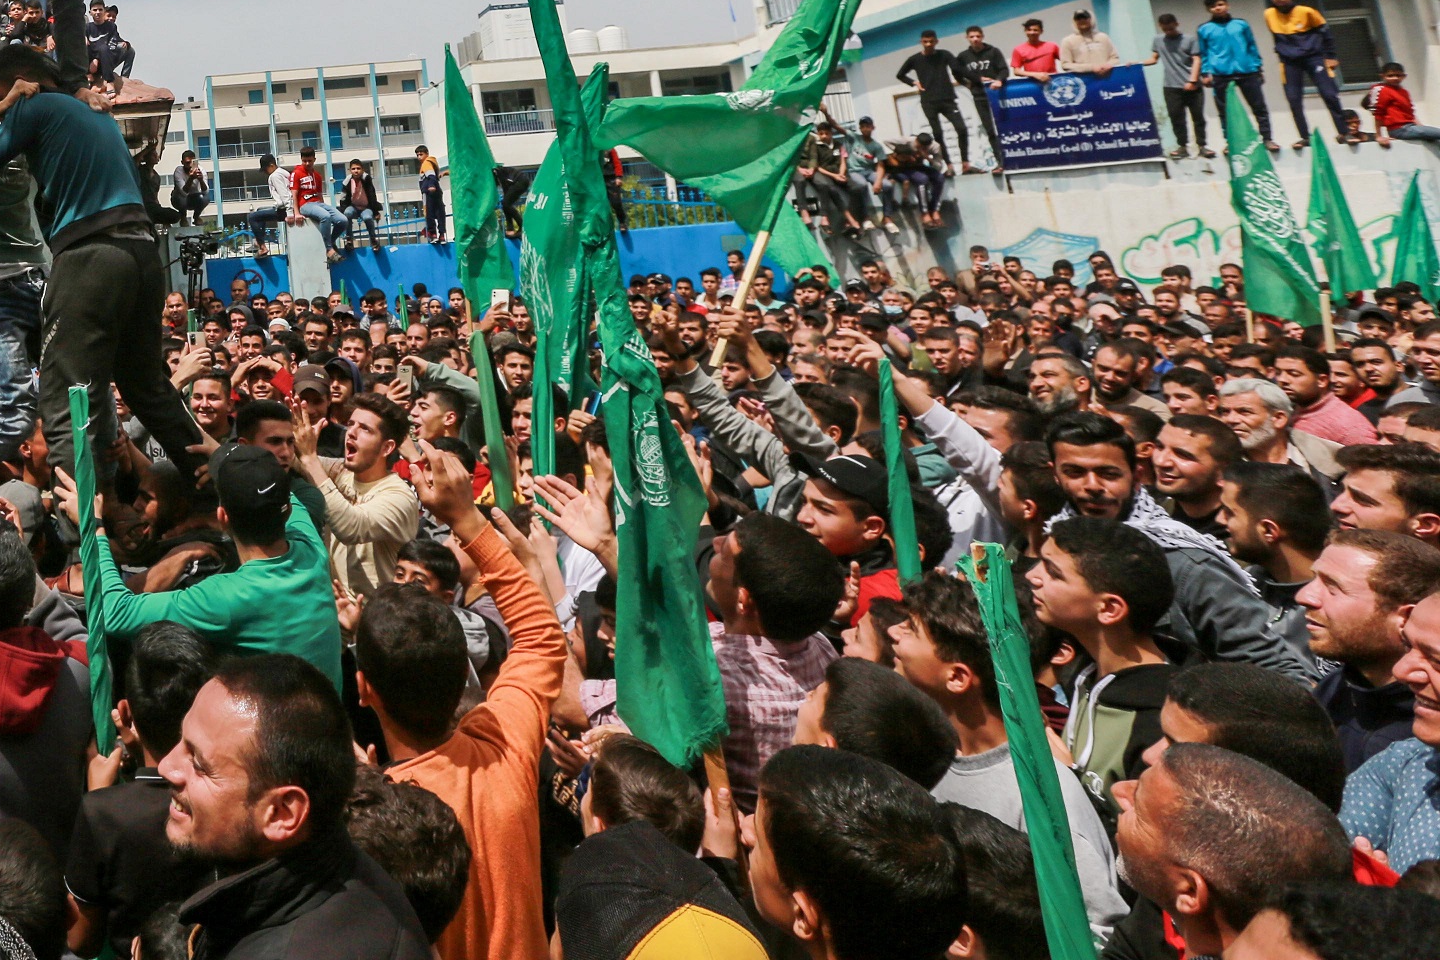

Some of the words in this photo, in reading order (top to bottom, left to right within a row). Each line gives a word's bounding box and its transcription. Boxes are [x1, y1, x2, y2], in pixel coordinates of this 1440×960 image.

[999, 96, 1038, 109] UNRWA
[1027, 144, 1061, 157] Elementary
[1095, 140, 1117, 151] School
[818, 467, 838, 484] NIKE
